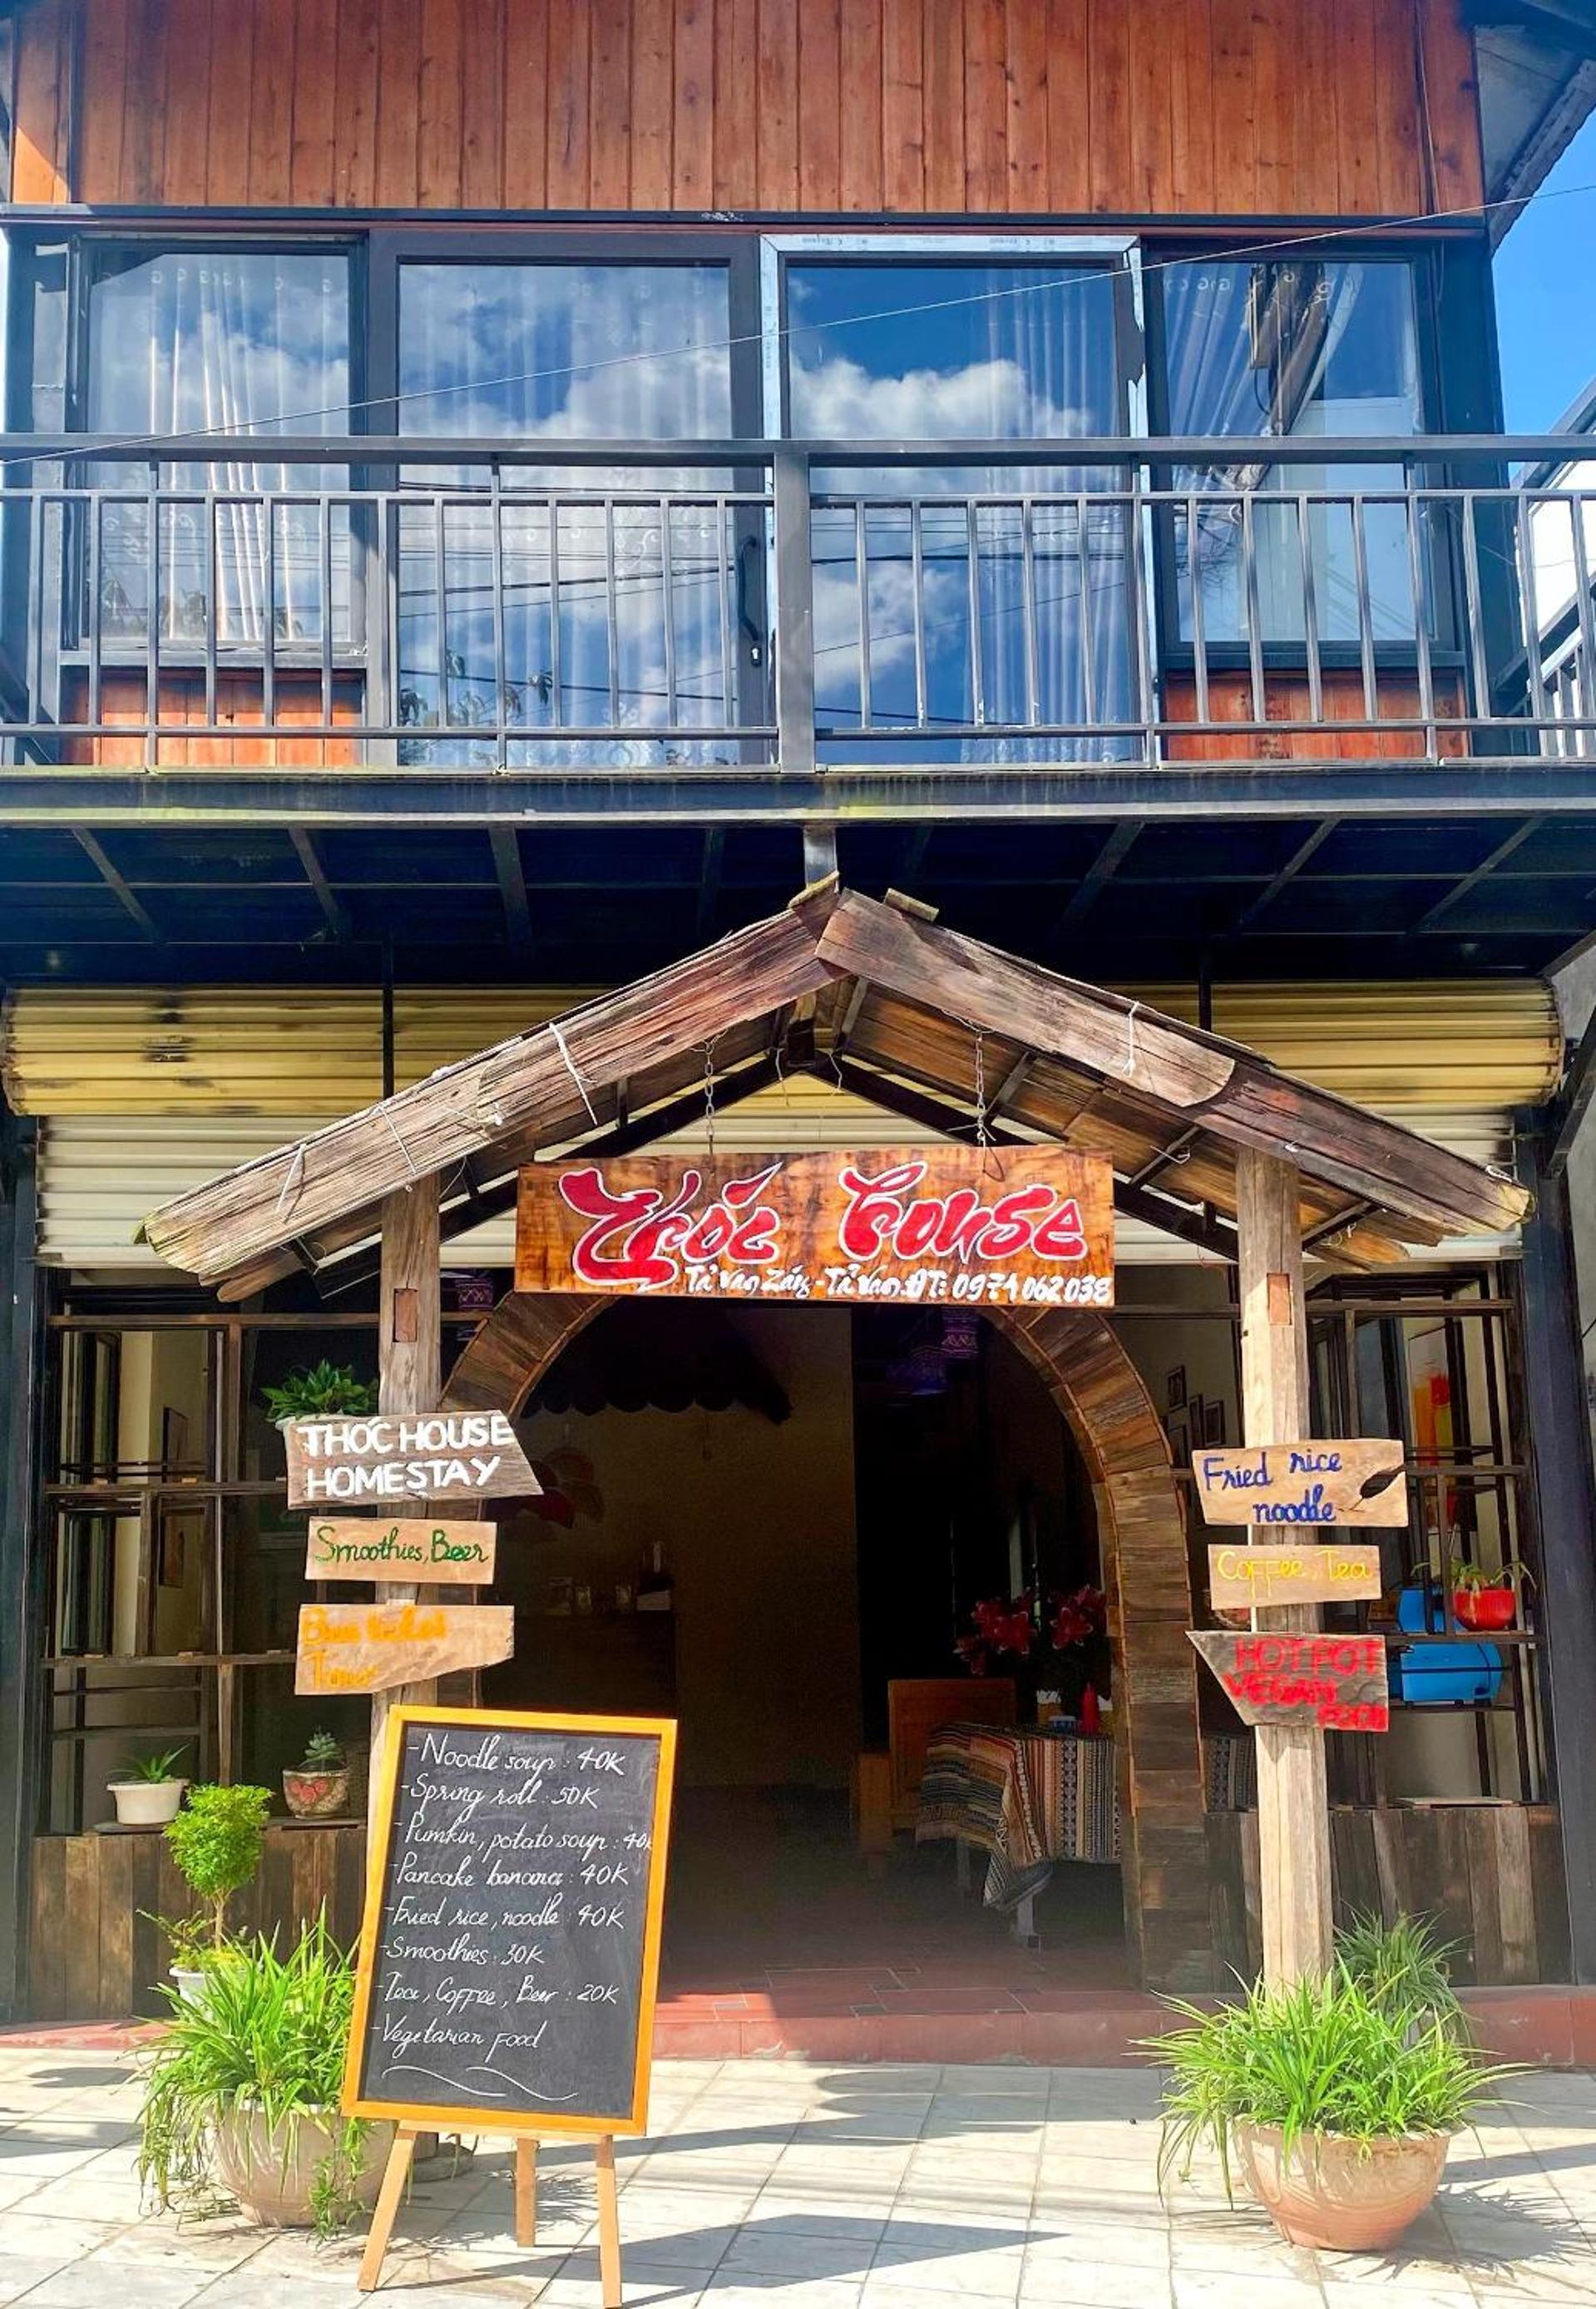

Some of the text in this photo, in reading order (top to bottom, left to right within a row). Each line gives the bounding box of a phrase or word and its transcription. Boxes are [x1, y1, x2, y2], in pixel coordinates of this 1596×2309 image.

[399, 1416, 514, 1452] HOUSE
[306, 1456, 500, 1498] HOMESTAY
[1203, 1449, 1342, 1491] Fried rice
[1253, 1484, 1337, 1522] noodle
[431, 1529, 488, 1563] Beer
[1315, 1550, 1371, 1581] Tea
[505, 1755, 556, 1783] soup
[577, 1747, 625, 1775] 40K
[490, 1779, 542, 1805] roll
[551, 1787, 600, 1809] 50K
[482, 1824, 553, 1863] potato
[556, 1832, 608, 1862] soup
[580, 1862, 628, 1885] 40K
[502, 1891, 563, 1926] noodle
[578, 1904, 624, 1929] 40K
[501, 1943, 545, 1965] 30K
[516, 1975, 559, 2004] Beer
[576, 1984, 619, 2005] 20K
